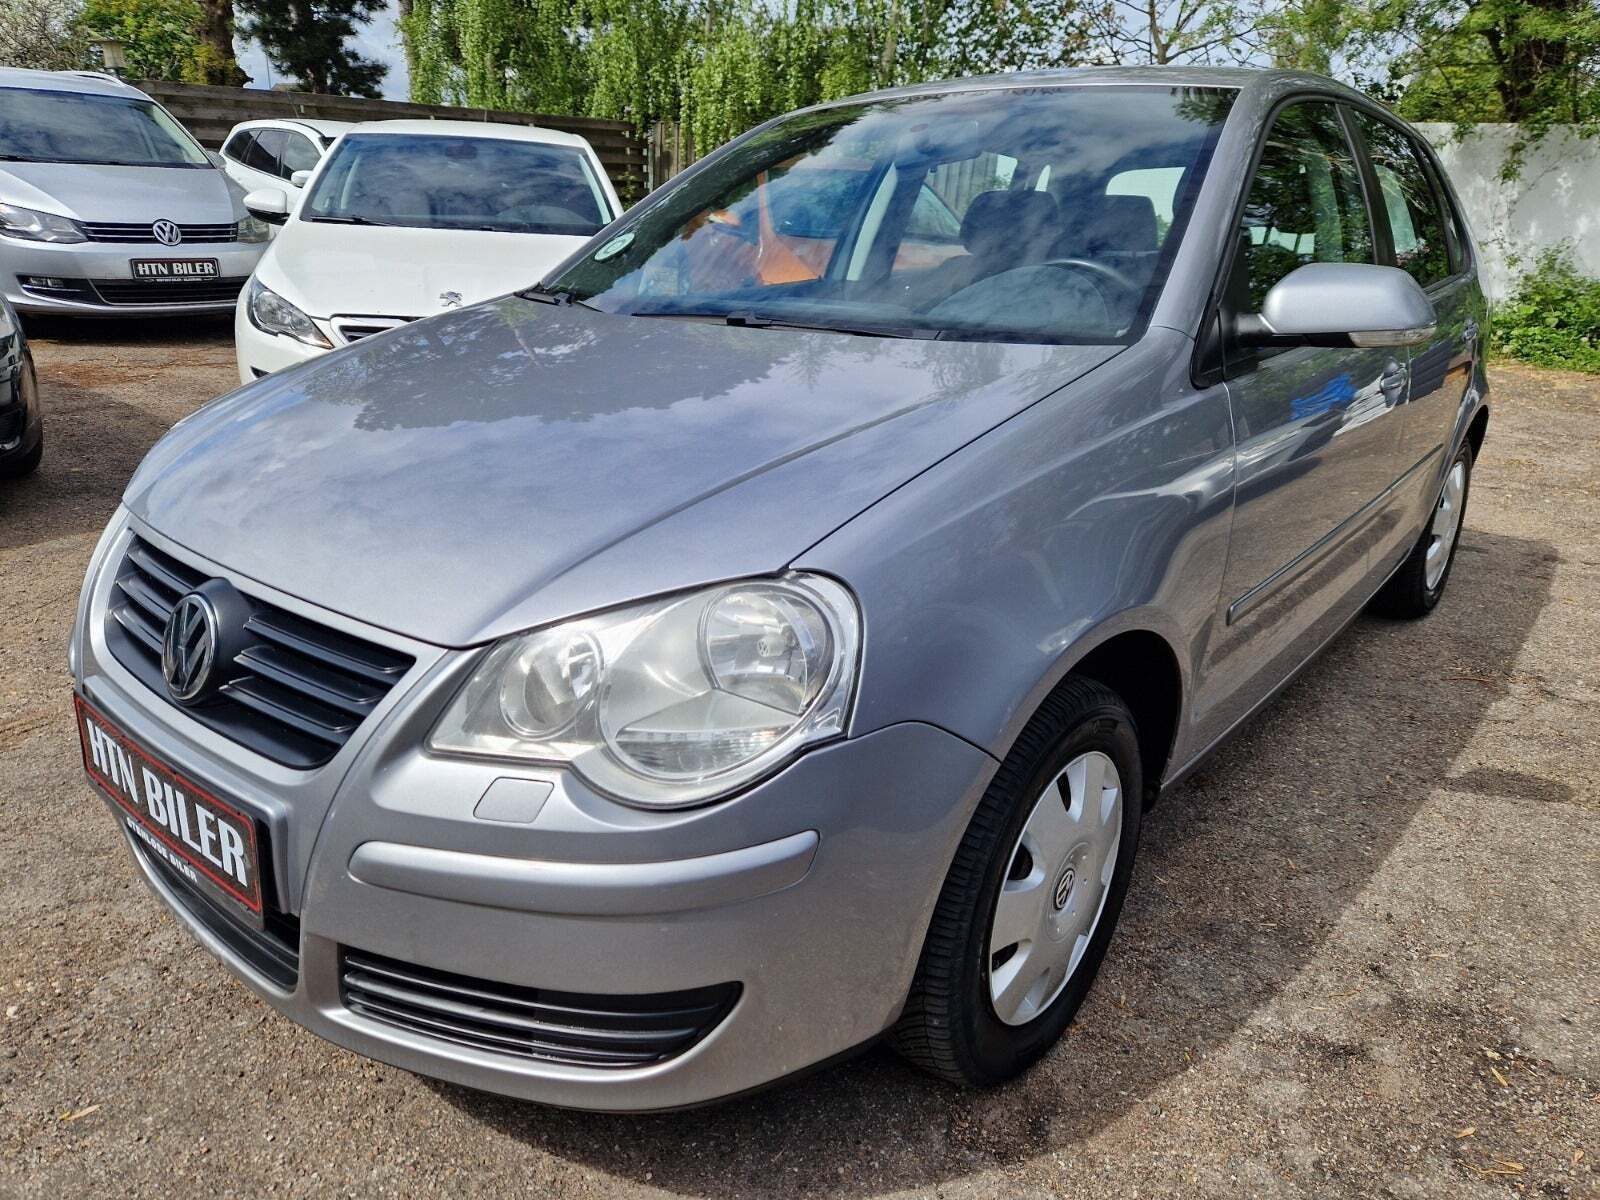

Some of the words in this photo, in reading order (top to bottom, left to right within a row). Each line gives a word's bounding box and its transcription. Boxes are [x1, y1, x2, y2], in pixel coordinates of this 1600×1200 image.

[137, 263, 168, 275] HTN
[172, 262, 215, 274] BILER
[86, 717, 138, 804] HTN
[142, 766, 248, 888] BILER
